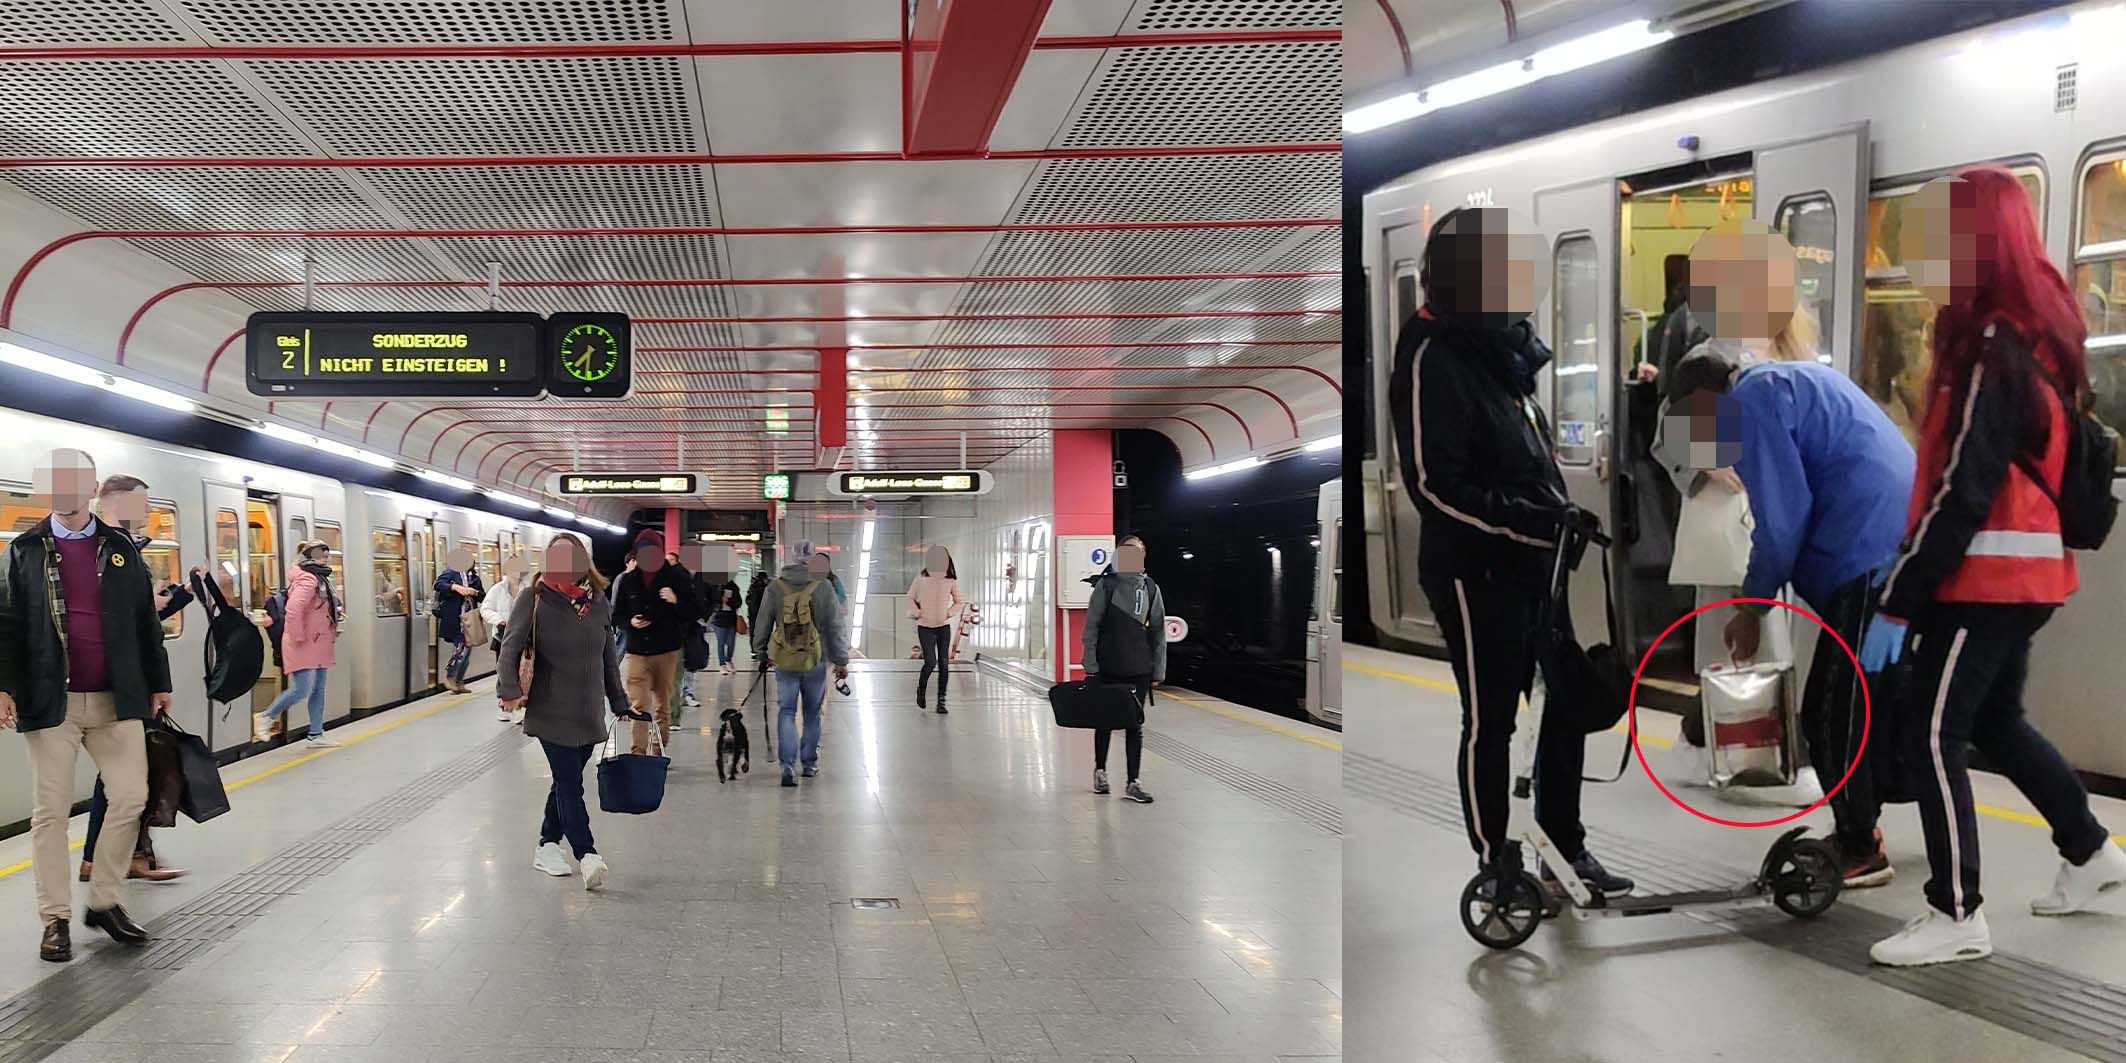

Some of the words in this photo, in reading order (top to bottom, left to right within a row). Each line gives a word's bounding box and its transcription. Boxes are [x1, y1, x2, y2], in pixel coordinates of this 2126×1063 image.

[372, 334, 468, 348] SONDERZUG
[282, 351, 295, 369] 2
[319, 358, 374, 372] NICHT
[382, 358, 488, 372] EINSTEIGEN
[499, 358, 506, 372] !
